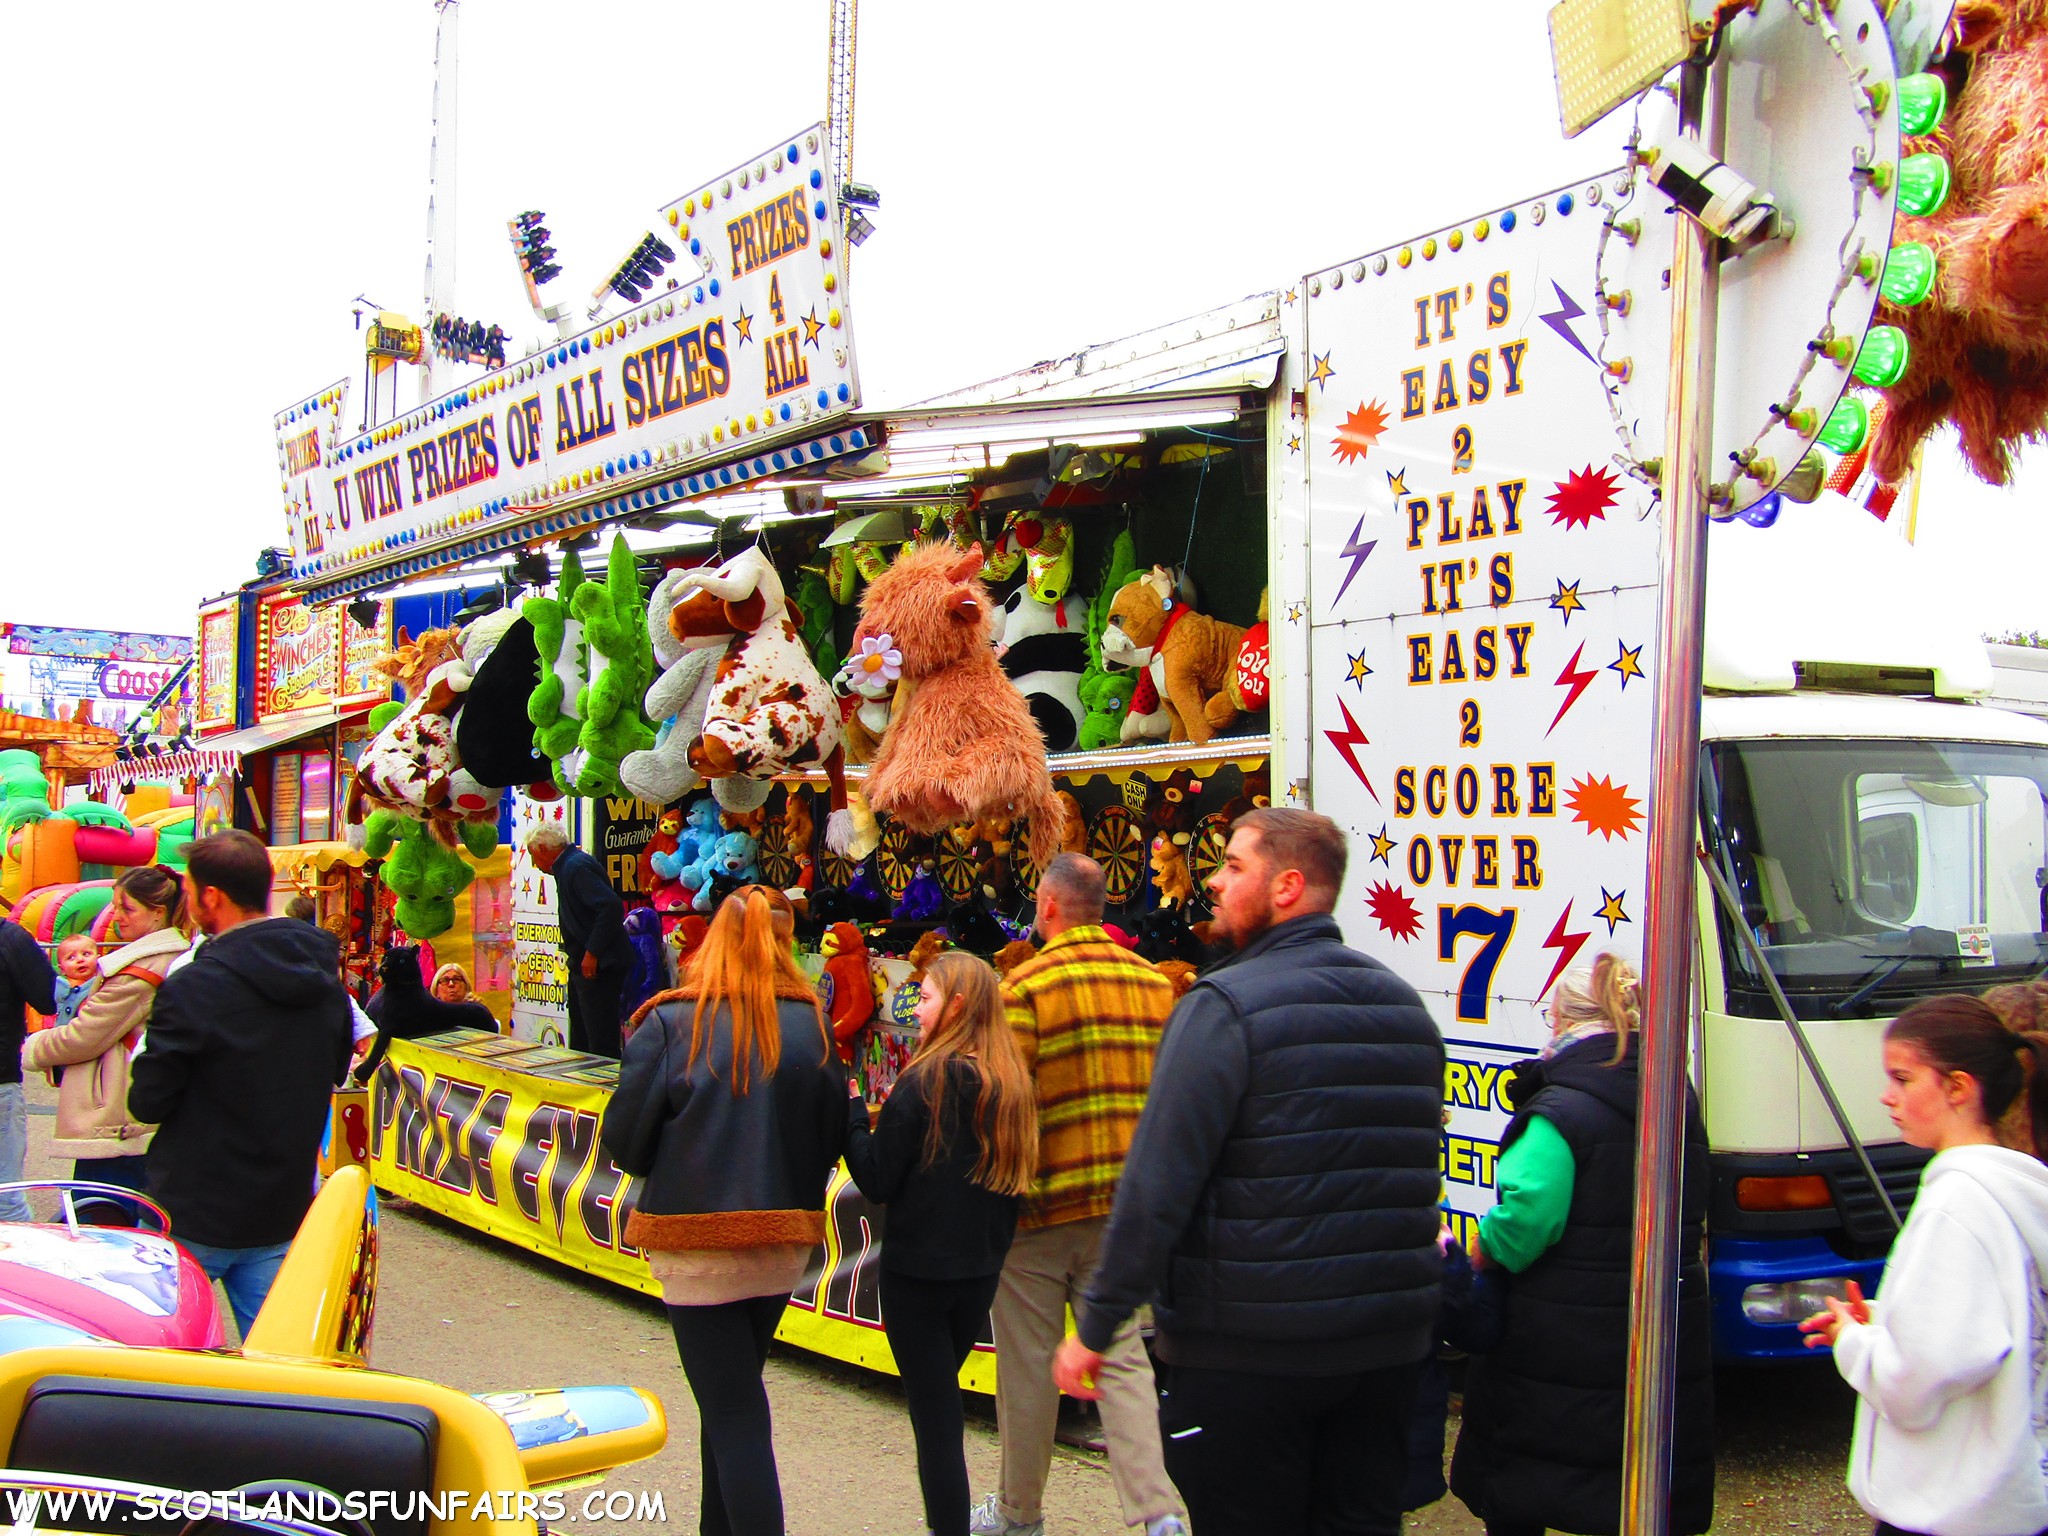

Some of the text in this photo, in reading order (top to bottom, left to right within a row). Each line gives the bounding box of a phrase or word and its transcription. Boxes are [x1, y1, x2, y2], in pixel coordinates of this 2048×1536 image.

[726, 184, 812, 280] PRIZES
[767, 270, 784, 327] 4
[1414, 270, 1510, 350] IT'S
[762, 327, 810, 402] ALL
[1400, 338, 1528, 421] EASY
[284, 425, 321, 478] PRIZES
[333, 315, 731, 532] U WIN PRIZES OF ALL SIZES
[1451, 423, 1474, 475] 2
[303, 513, 325, 557] ALL
[1406, 478, 1526, 551] PLAY
[1420, 552, 1514, 616] IT'S
[287, 664, 321, 693] SHOOTING
[1407, 622, 1534, 687] EASY
[1459, 698, 1482, 748] 2
[605, 798, 665, 821] WIN
[1124, 782, 1146, 799] CASH
[1127, 794, 1144, 809] ONL
[1393, 761, 1557, 819] SCORE
[1407, 834, 1543, 890] OVER
[516, 921, 564, 943] EVERYON
[528, 952, 554, 973] GETS
[1437, 903, 1518, 1026] 7
[528, 981, 563, 1004] MINION
[370, 1058, 512, 1207] PRIZE
